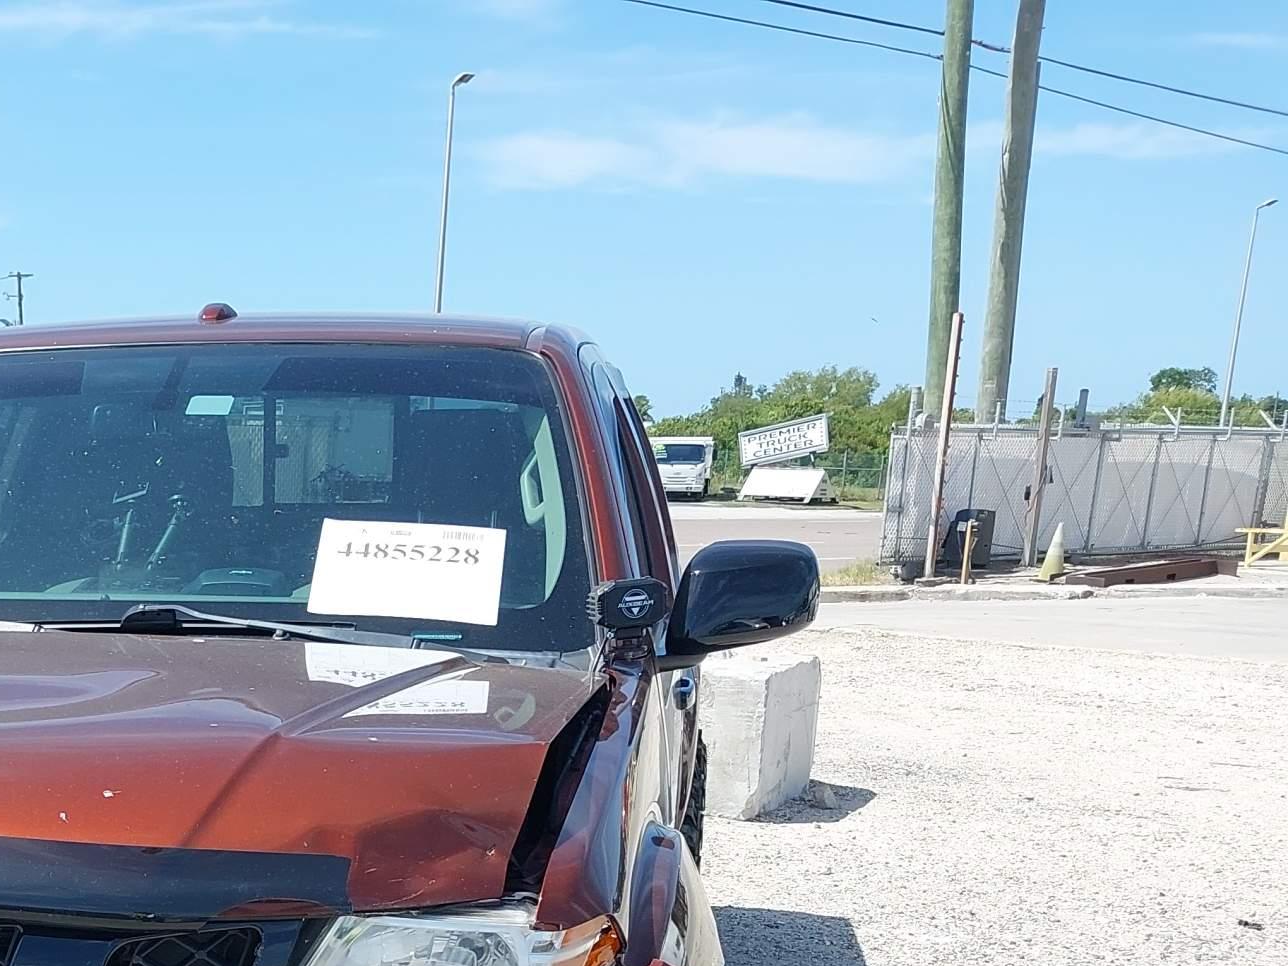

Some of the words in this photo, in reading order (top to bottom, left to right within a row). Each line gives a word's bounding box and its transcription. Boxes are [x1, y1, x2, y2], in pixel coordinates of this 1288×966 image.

[747, 422, 817, 444] PREMIER
[757, 432, 809, 449] TRUCK
[753, 440, 814, 458] CENTER
[338, 541, 480, 565] 44855228
